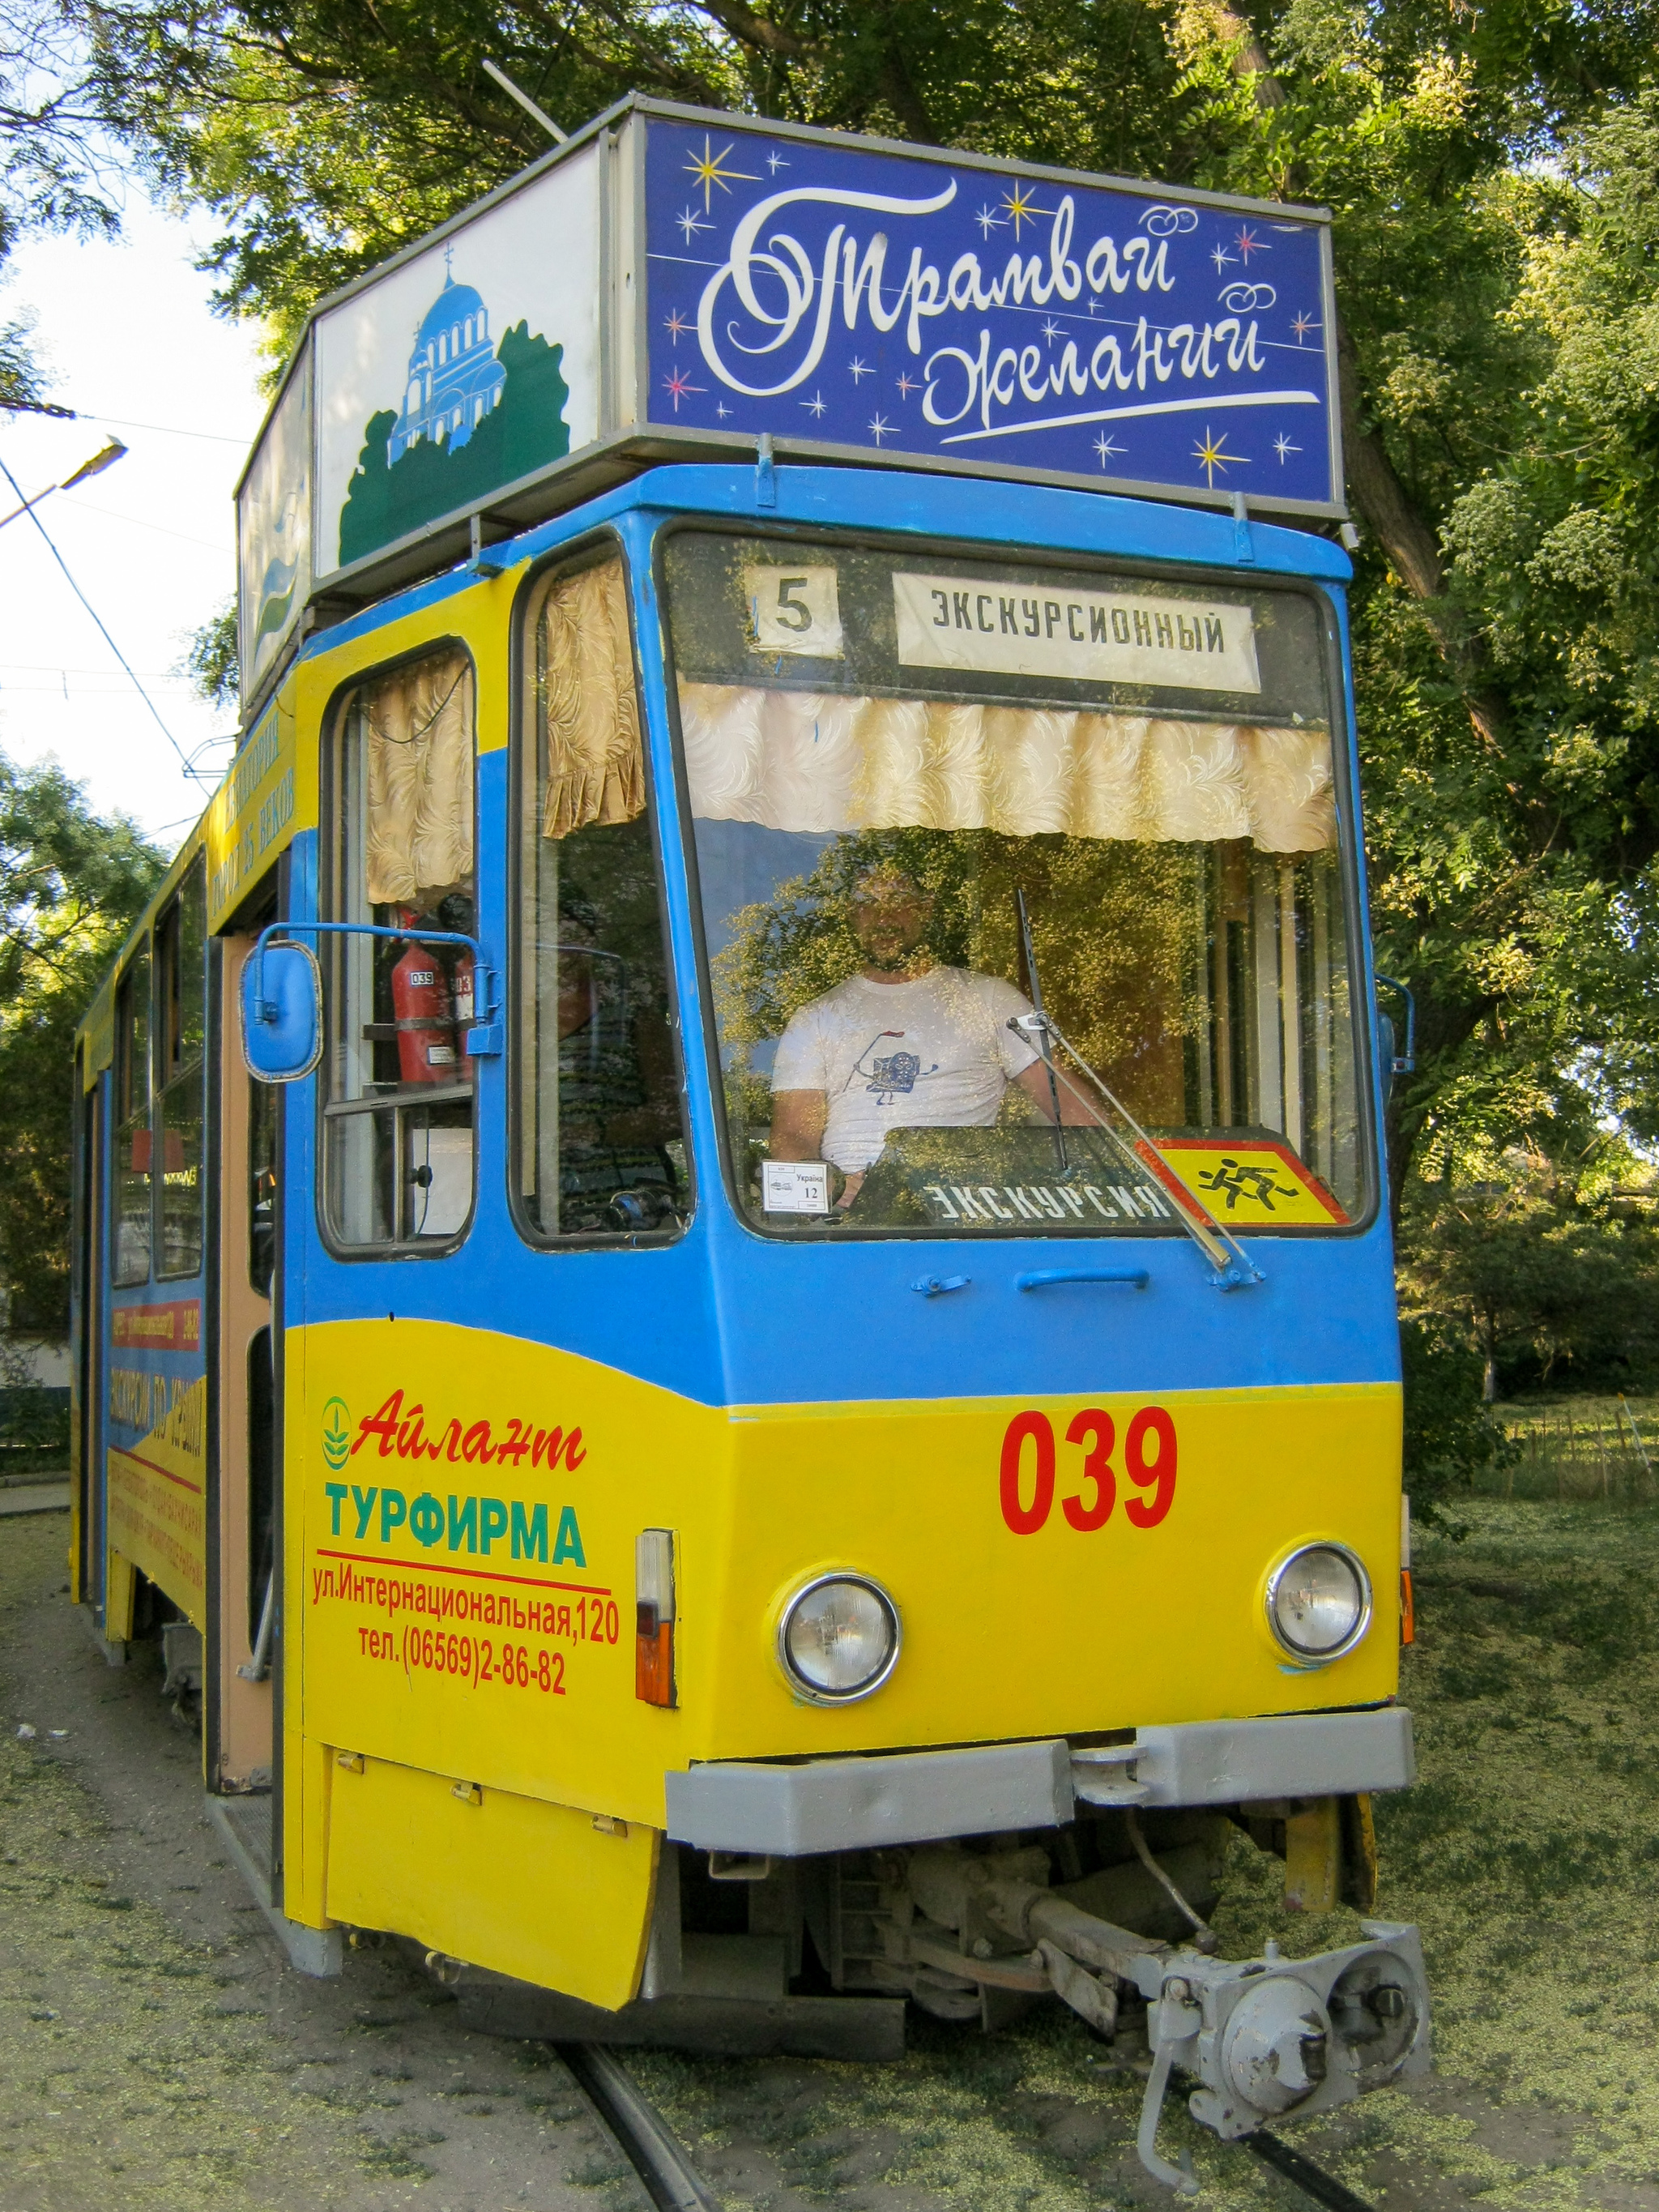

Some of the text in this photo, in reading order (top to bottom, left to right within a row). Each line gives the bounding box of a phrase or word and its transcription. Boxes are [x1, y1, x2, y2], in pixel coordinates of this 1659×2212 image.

[697, 177, 1199, 396] Трамвай
[922, 281, 1277, 429] Желаний
[775, 576, 812, 633] 5
[931, 589, 1226, 654] ЭКСКУРСИОННЫЙ
[259, 767, 294, 856] ВЕКОВ
[412, 973, 433, 984] 039
[796, 1173, 823, 1183] Україна
[804, 1187, 817, 1198] 12
[923, 1185, 1171, 1219] ЭКСКУРСИЯ
[350, 1389, 587, 1472] Айлант
[1000, 1406, 1178, 1535] 039
[325, 1482, 587, 1569] ТУРФИРМА
